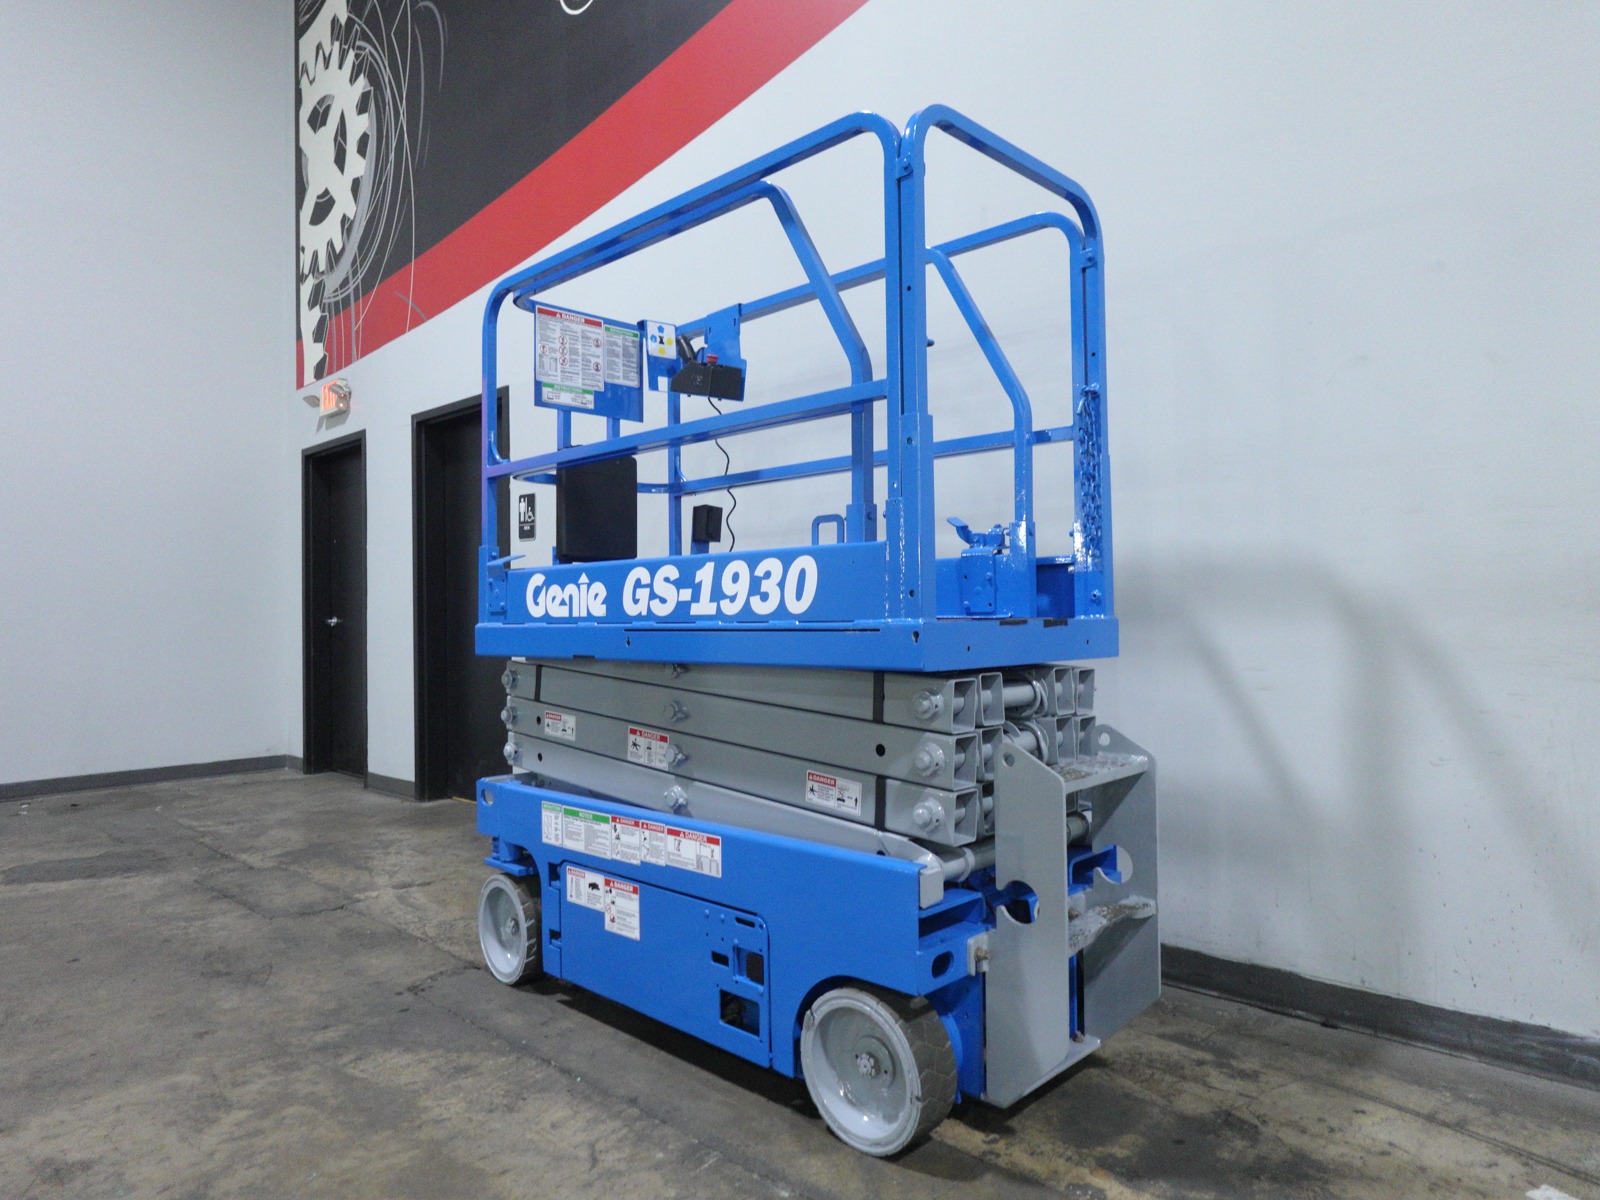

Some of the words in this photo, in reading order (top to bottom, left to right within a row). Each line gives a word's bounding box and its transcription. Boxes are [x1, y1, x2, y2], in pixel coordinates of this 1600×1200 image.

[562, 313, 585, 324] DANGER
[526, 572, 607, 618] Genie
[622, 555, 818, 617] GS-1930
[642, 731, 661, 740] DANGER
[813, 774, 835, 785] DANGER
[647, 822, 664, 832] DANGER
[684, 831, 708, 843] DANGER
[614, 881, 634, 892] DANGER
